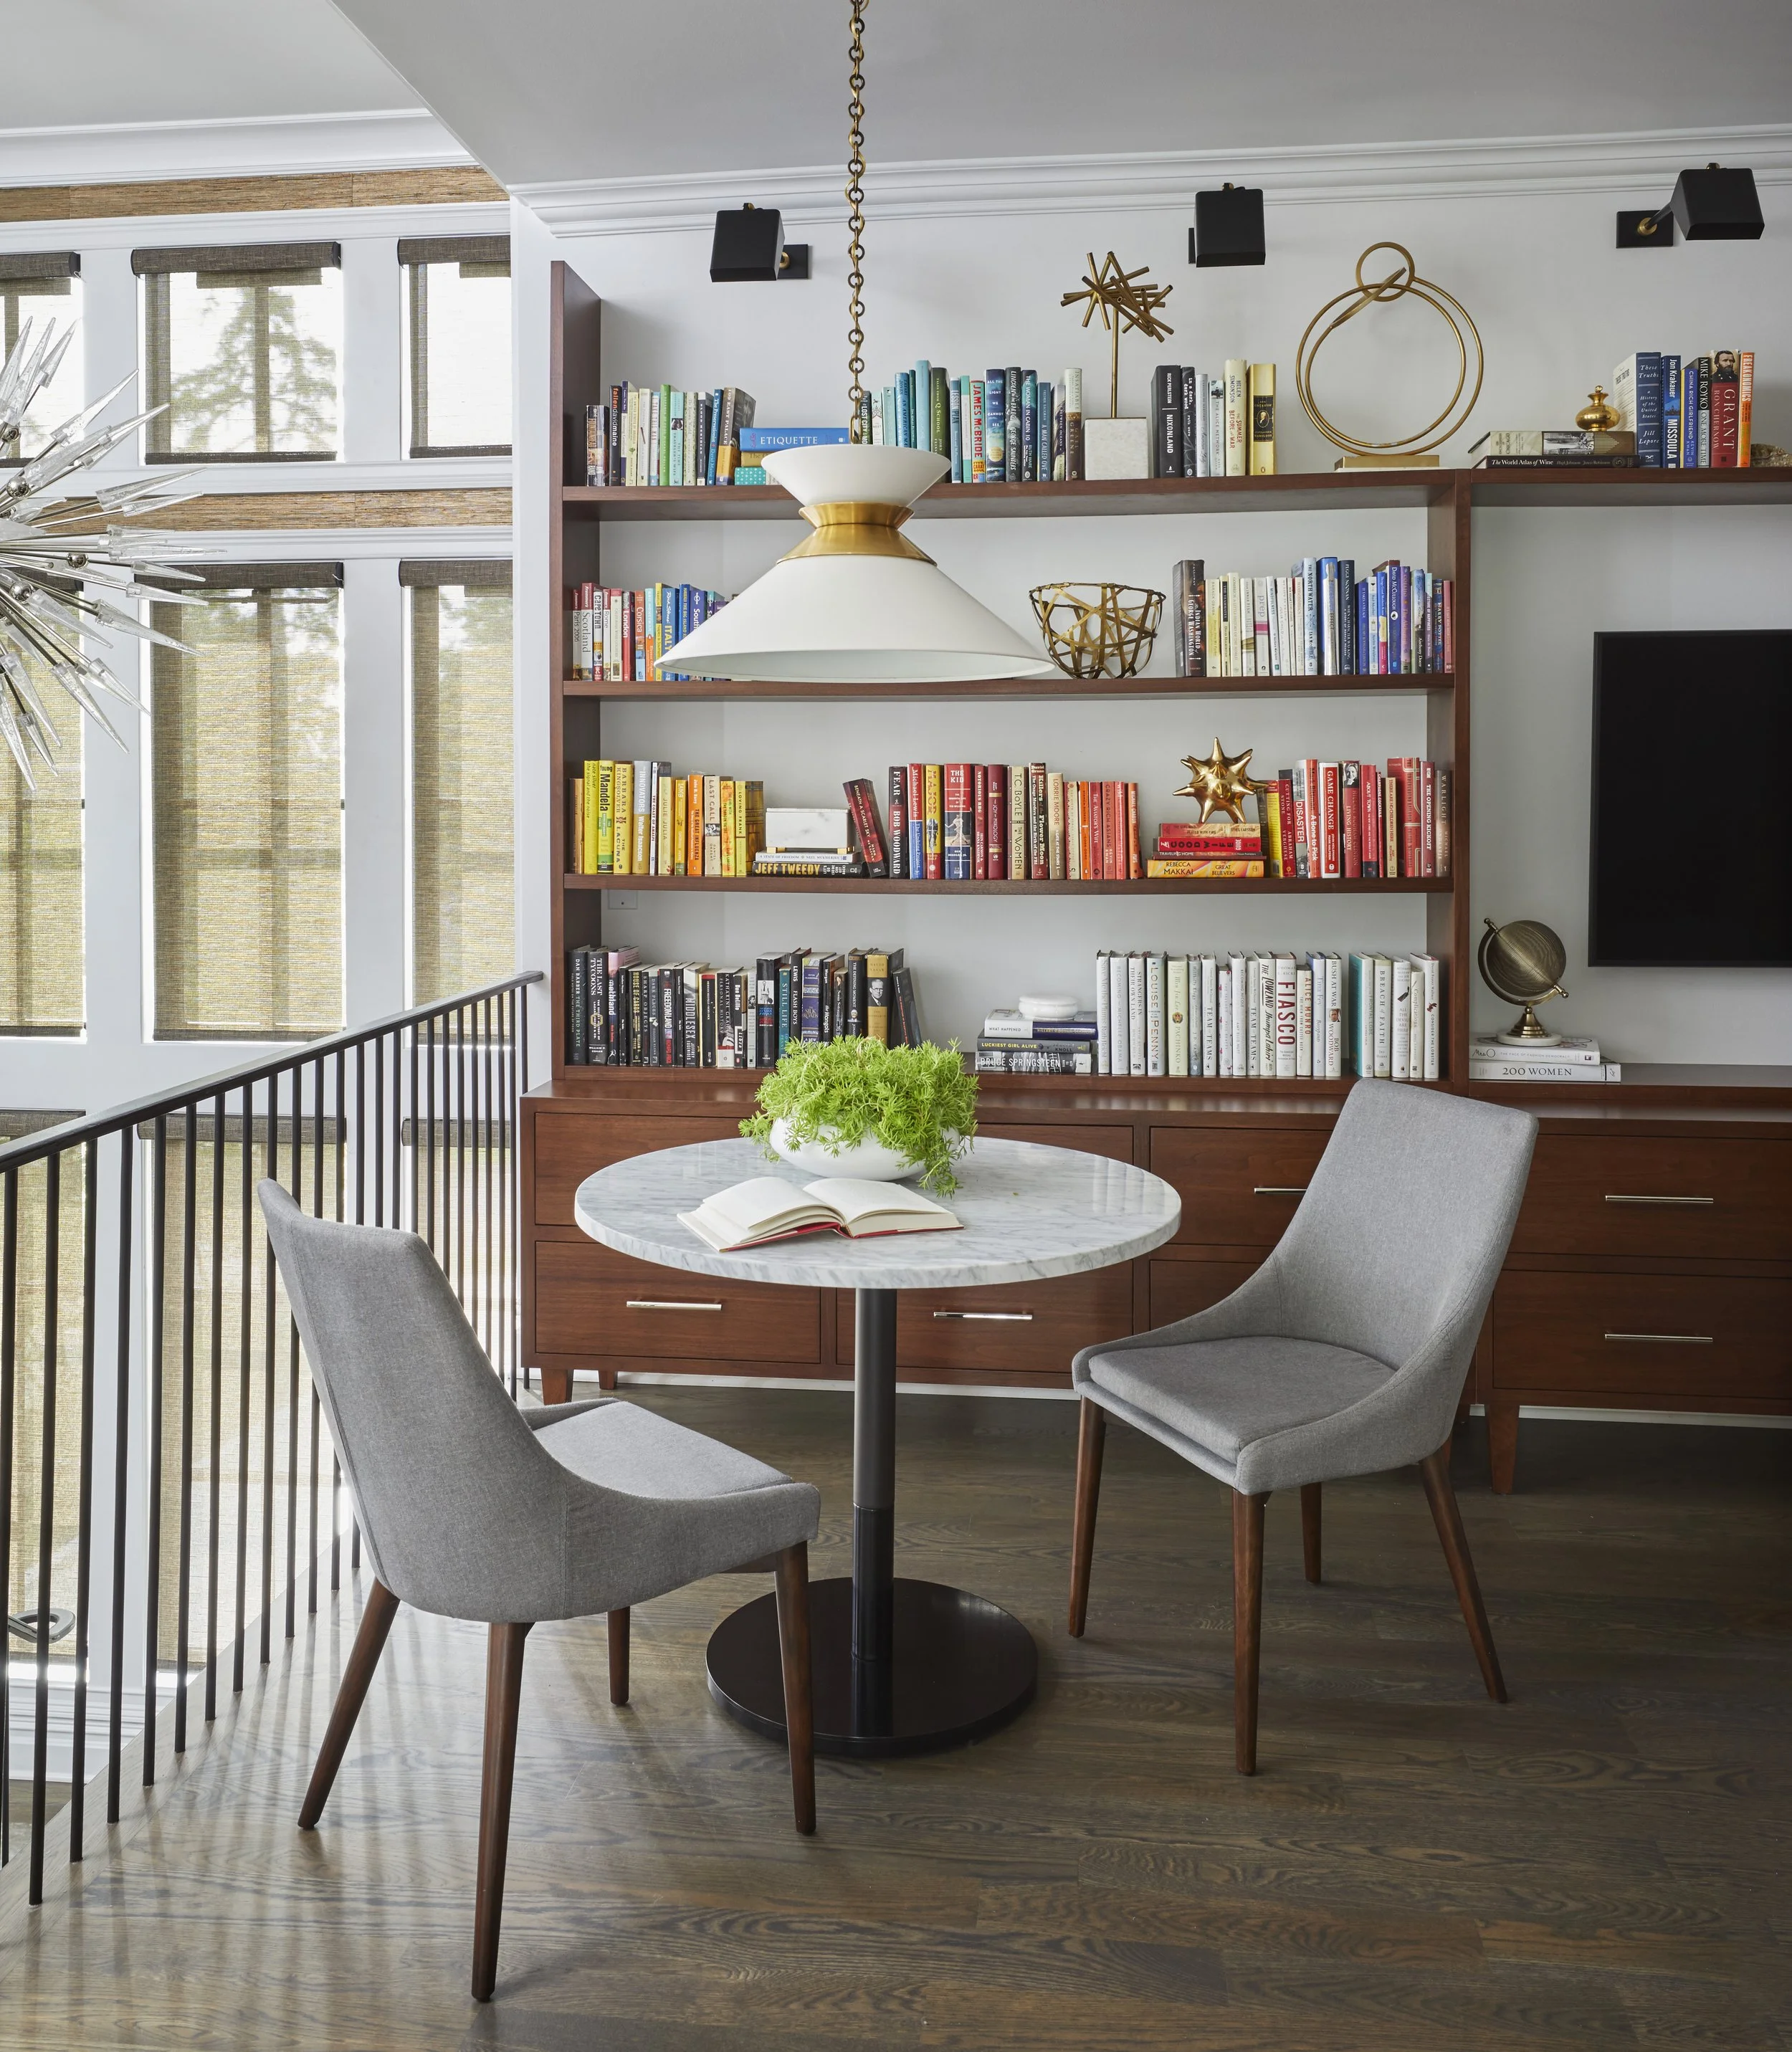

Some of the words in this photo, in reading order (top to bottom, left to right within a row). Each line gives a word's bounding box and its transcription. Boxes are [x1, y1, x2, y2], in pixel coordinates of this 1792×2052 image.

[1742, 355, 1752, 401] FREAKONOMICS
[973, 385, 982, 415] JAMES
[1723, 389, 1735, 449] GRANT
[1668, 419, 1677, 459] MISSOULA
[600, 774, 610, 811] Mandela
[756, 864, 778, 874] JEFF
[781, 864, 820, 874] TWEEDY
[1262, 977, 1273, 1008] LOWLAND
[1332, 981, 1336, 991] AT
[685, 998, 695, 1039] MIDDLESEX
[1278, 982, 1295, 1045] FIASCO
[1009, 1059, 1060, 1067] SPRINGSTEEN
